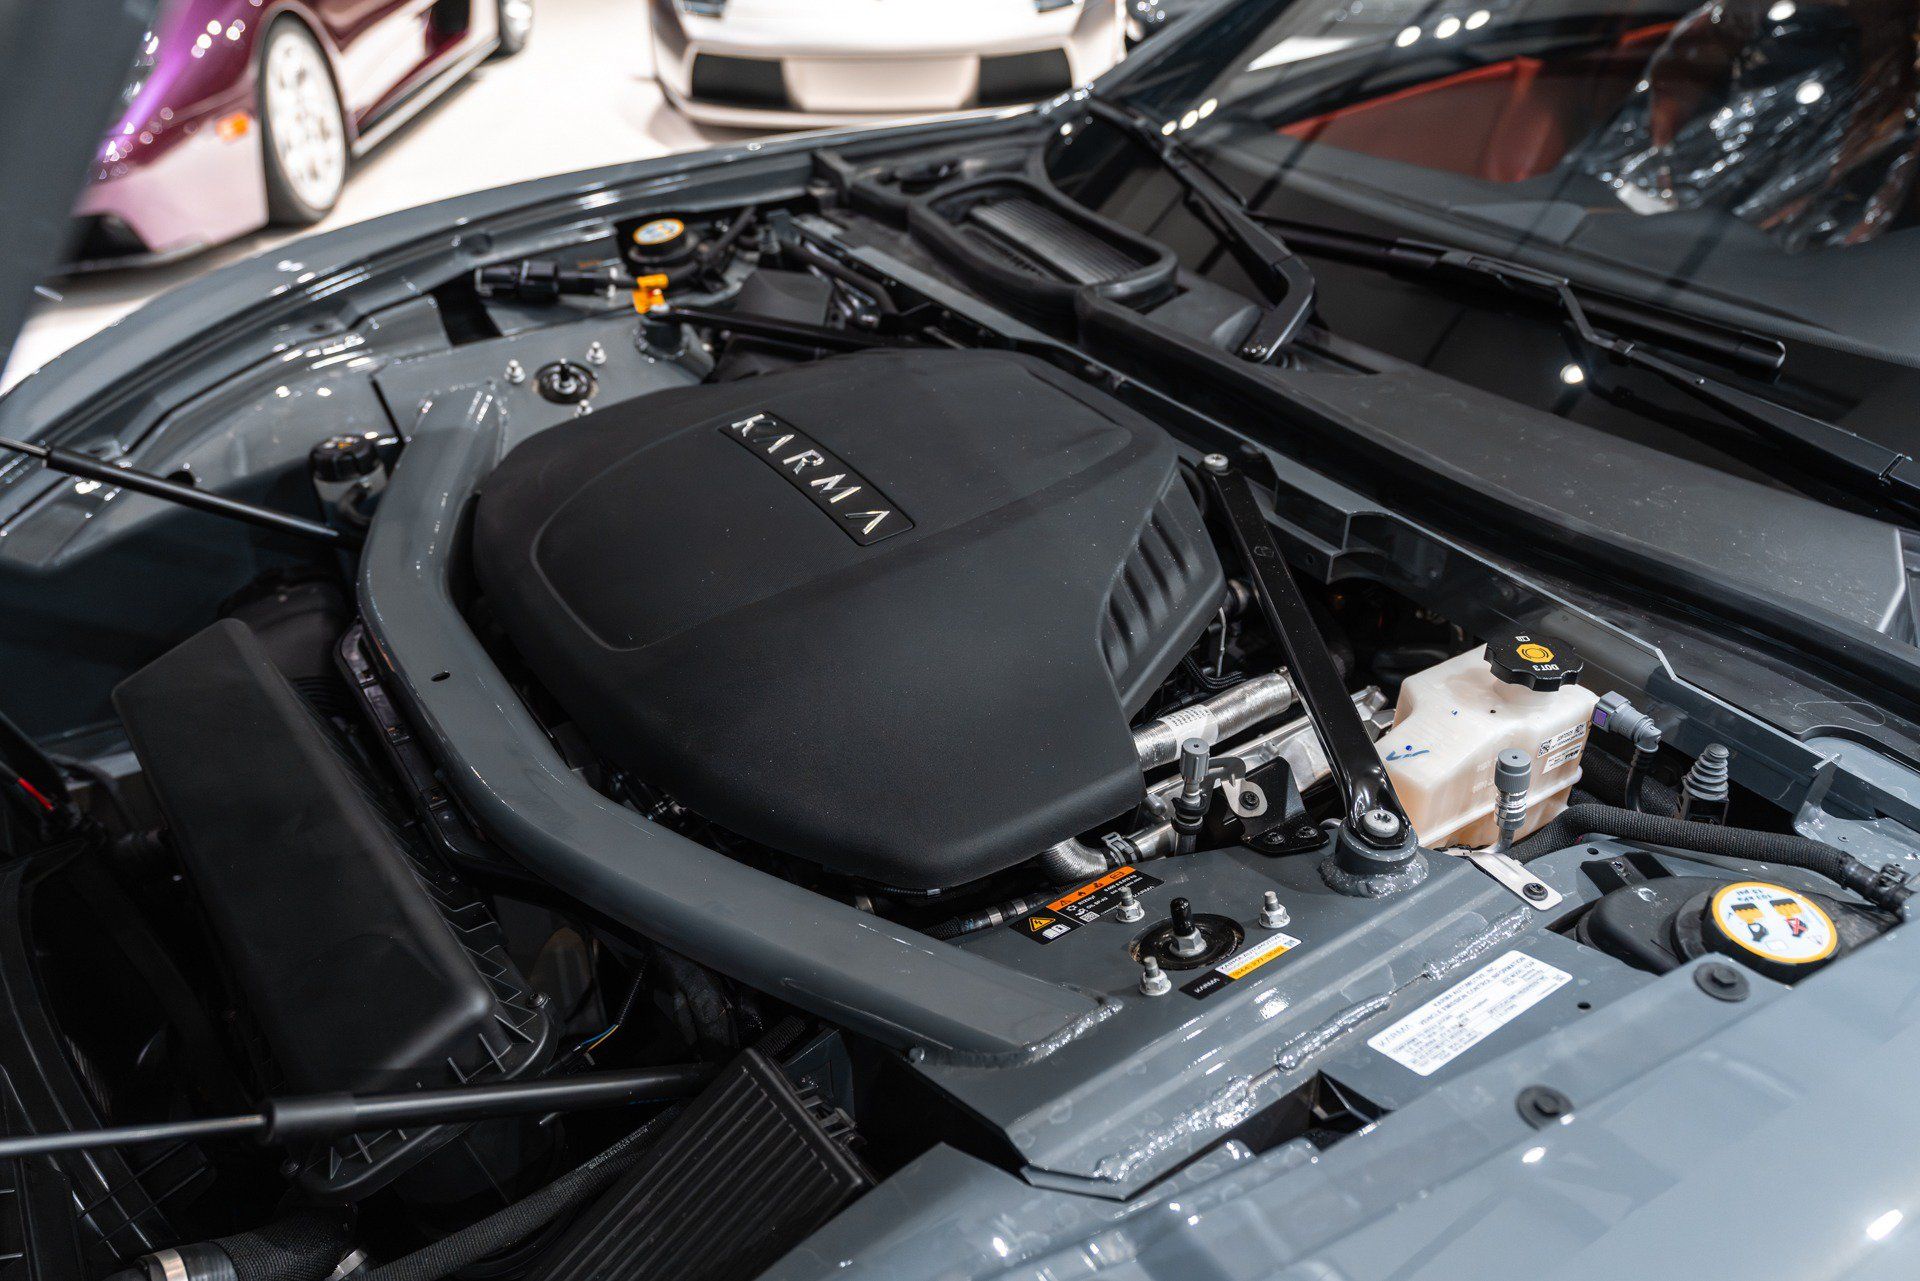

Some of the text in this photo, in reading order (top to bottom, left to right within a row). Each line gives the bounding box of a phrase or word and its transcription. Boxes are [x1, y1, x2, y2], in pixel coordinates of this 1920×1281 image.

[730, 413, 891, 536] KARMA
[1541, 663, 1560, 671] DOT
[1193, 977, 1221, 994] KARMA
